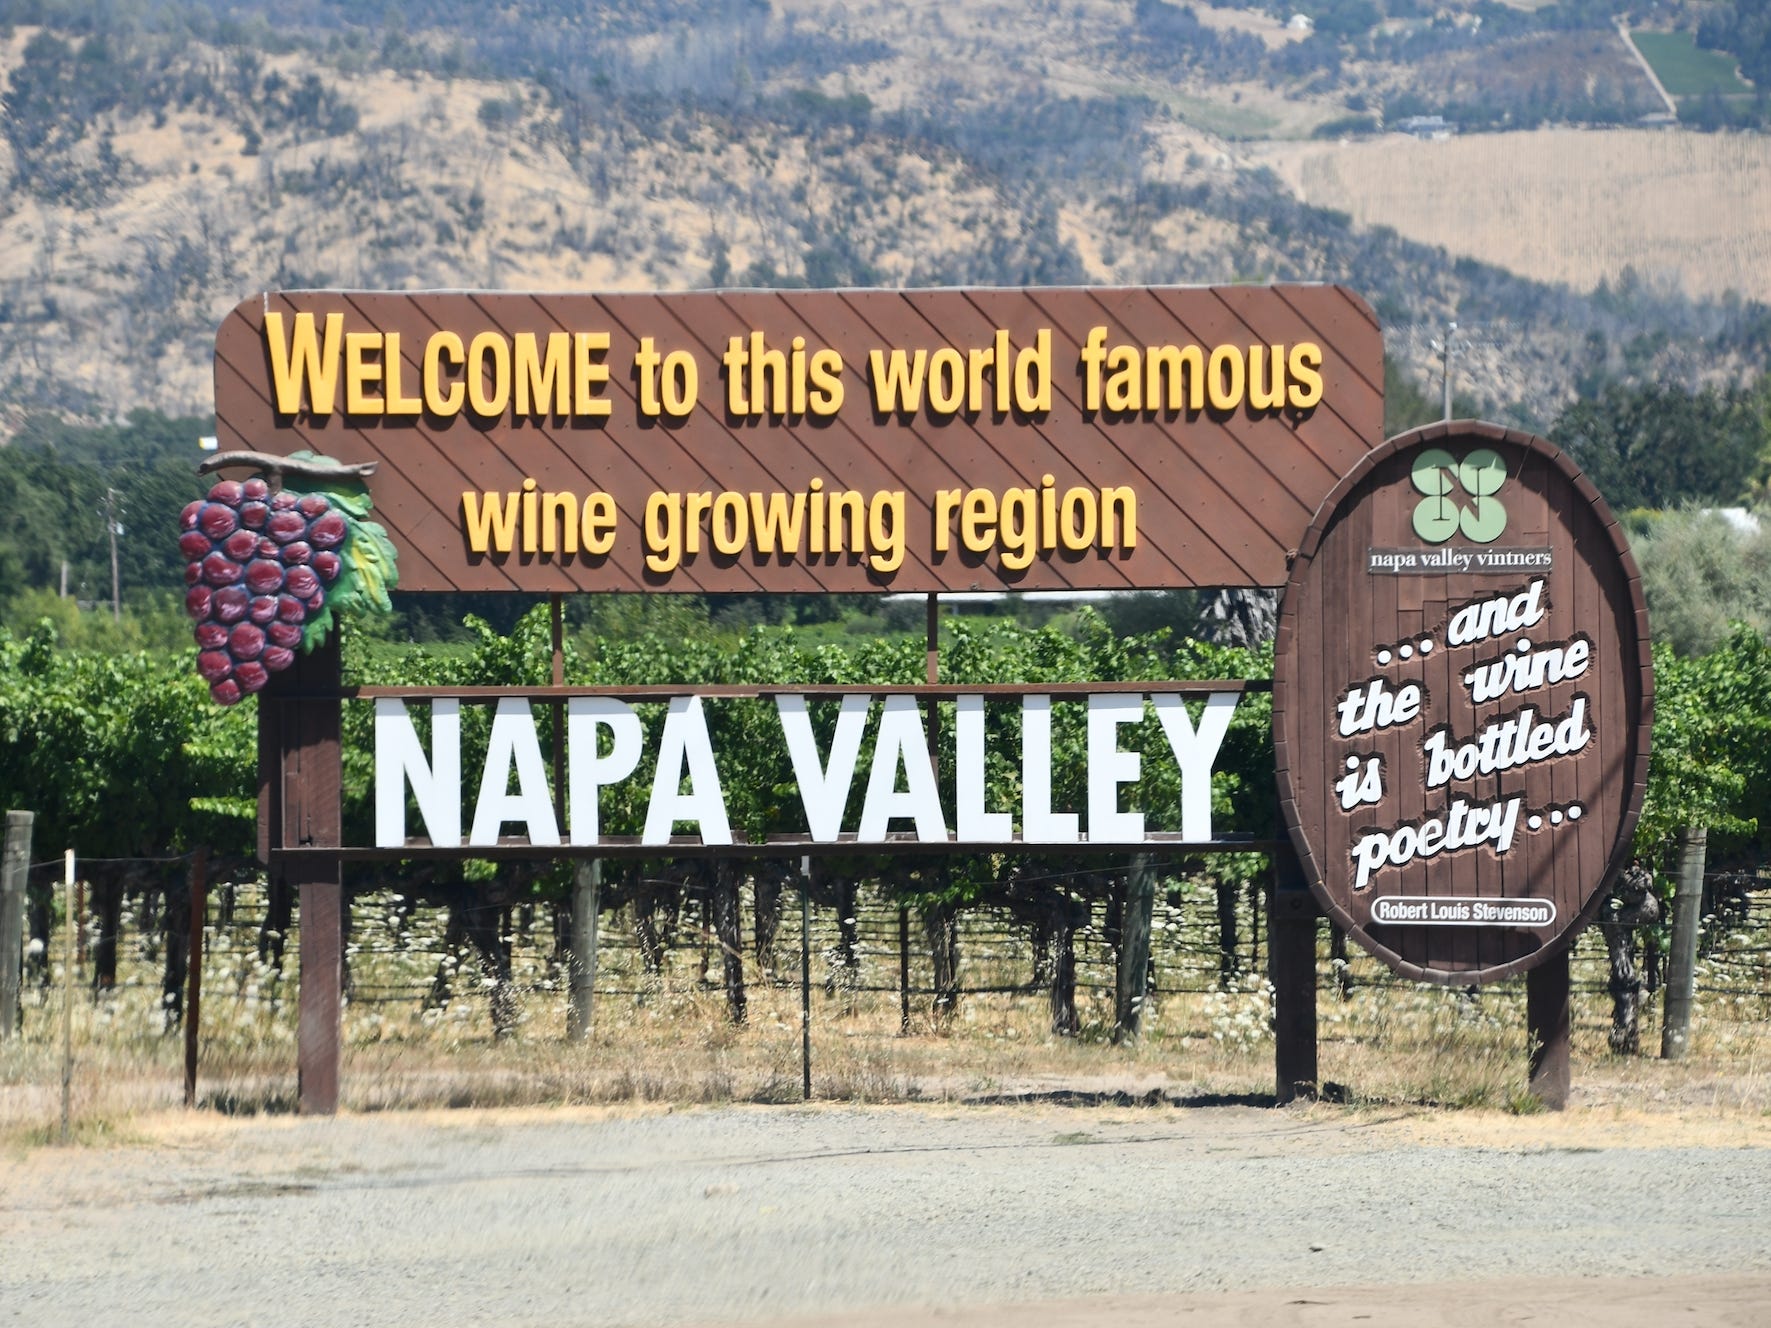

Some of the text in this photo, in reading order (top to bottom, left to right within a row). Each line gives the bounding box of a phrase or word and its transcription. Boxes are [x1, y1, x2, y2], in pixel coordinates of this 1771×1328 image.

[264, 312, 1324, 417] WELCOME to this world famous
[462, 473, 1137, 573] wine growing region
[1370, 548, 1553, 572] napa valley vintners
[1337, 638, 1590, 737] the wine
[374, 692, 1240, 848] NAPA VALLEY
[1335, 698, 1591, 810] is bottled
[1379, 902, 1548, 921] Robert Louis Stevenson
